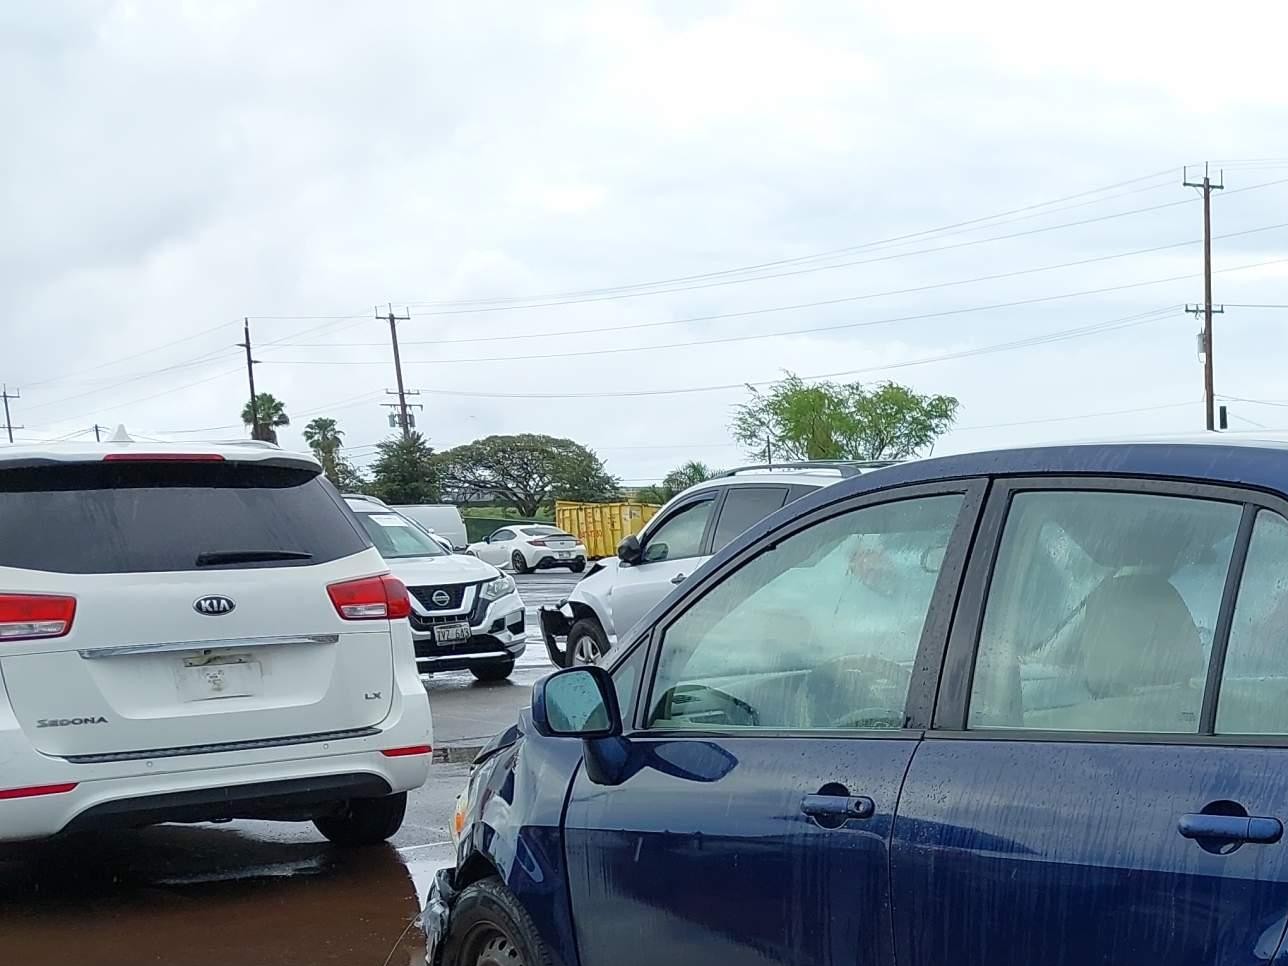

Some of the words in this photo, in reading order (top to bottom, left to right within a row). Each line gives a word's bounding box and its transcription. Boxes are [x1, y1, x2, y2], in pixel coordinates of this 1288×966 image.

[200, 599, 230, 612] KIA
[364, 691, 382, 700] LX
[36, 716, 109, 728] SEDONA
